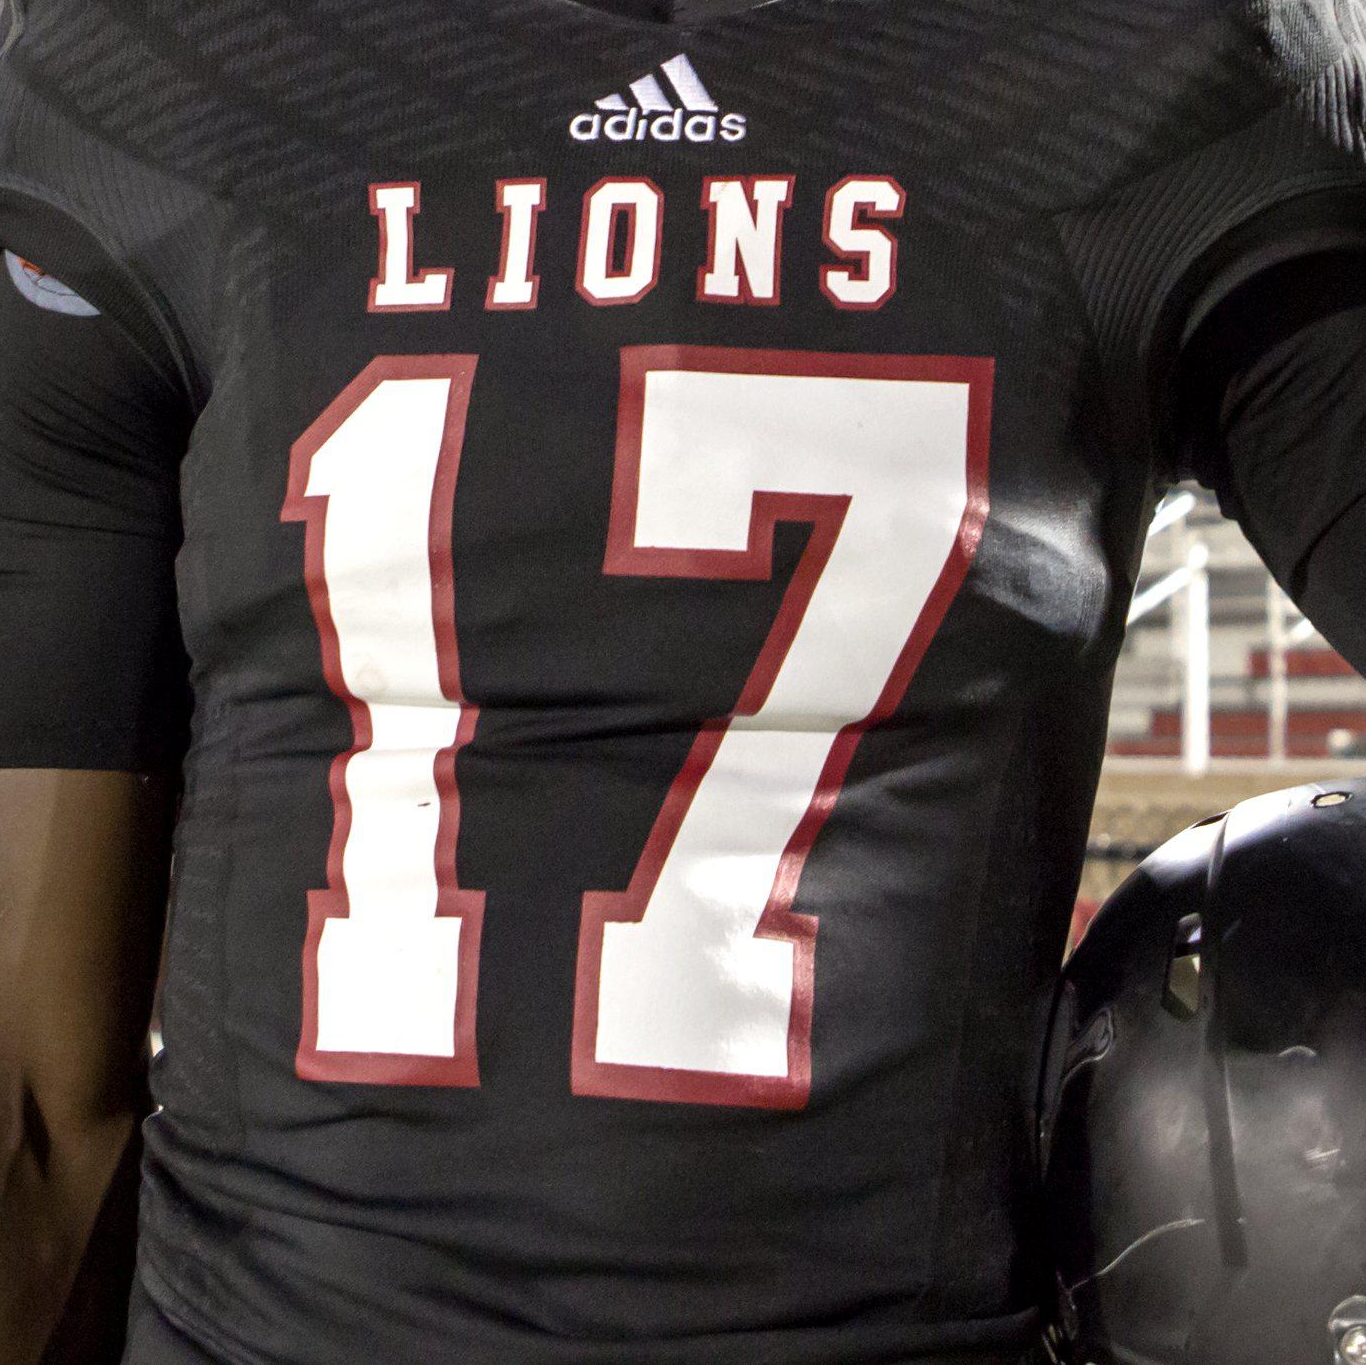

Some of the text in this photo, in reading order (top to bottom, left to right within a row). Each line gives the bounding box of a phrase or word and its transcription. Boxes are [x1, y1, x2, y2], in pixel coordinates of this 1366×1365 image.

[568, 106, 748, 143] adidas
[368, 176, 906, 311] LIONS
[280, 346, 996, 1109] 17
